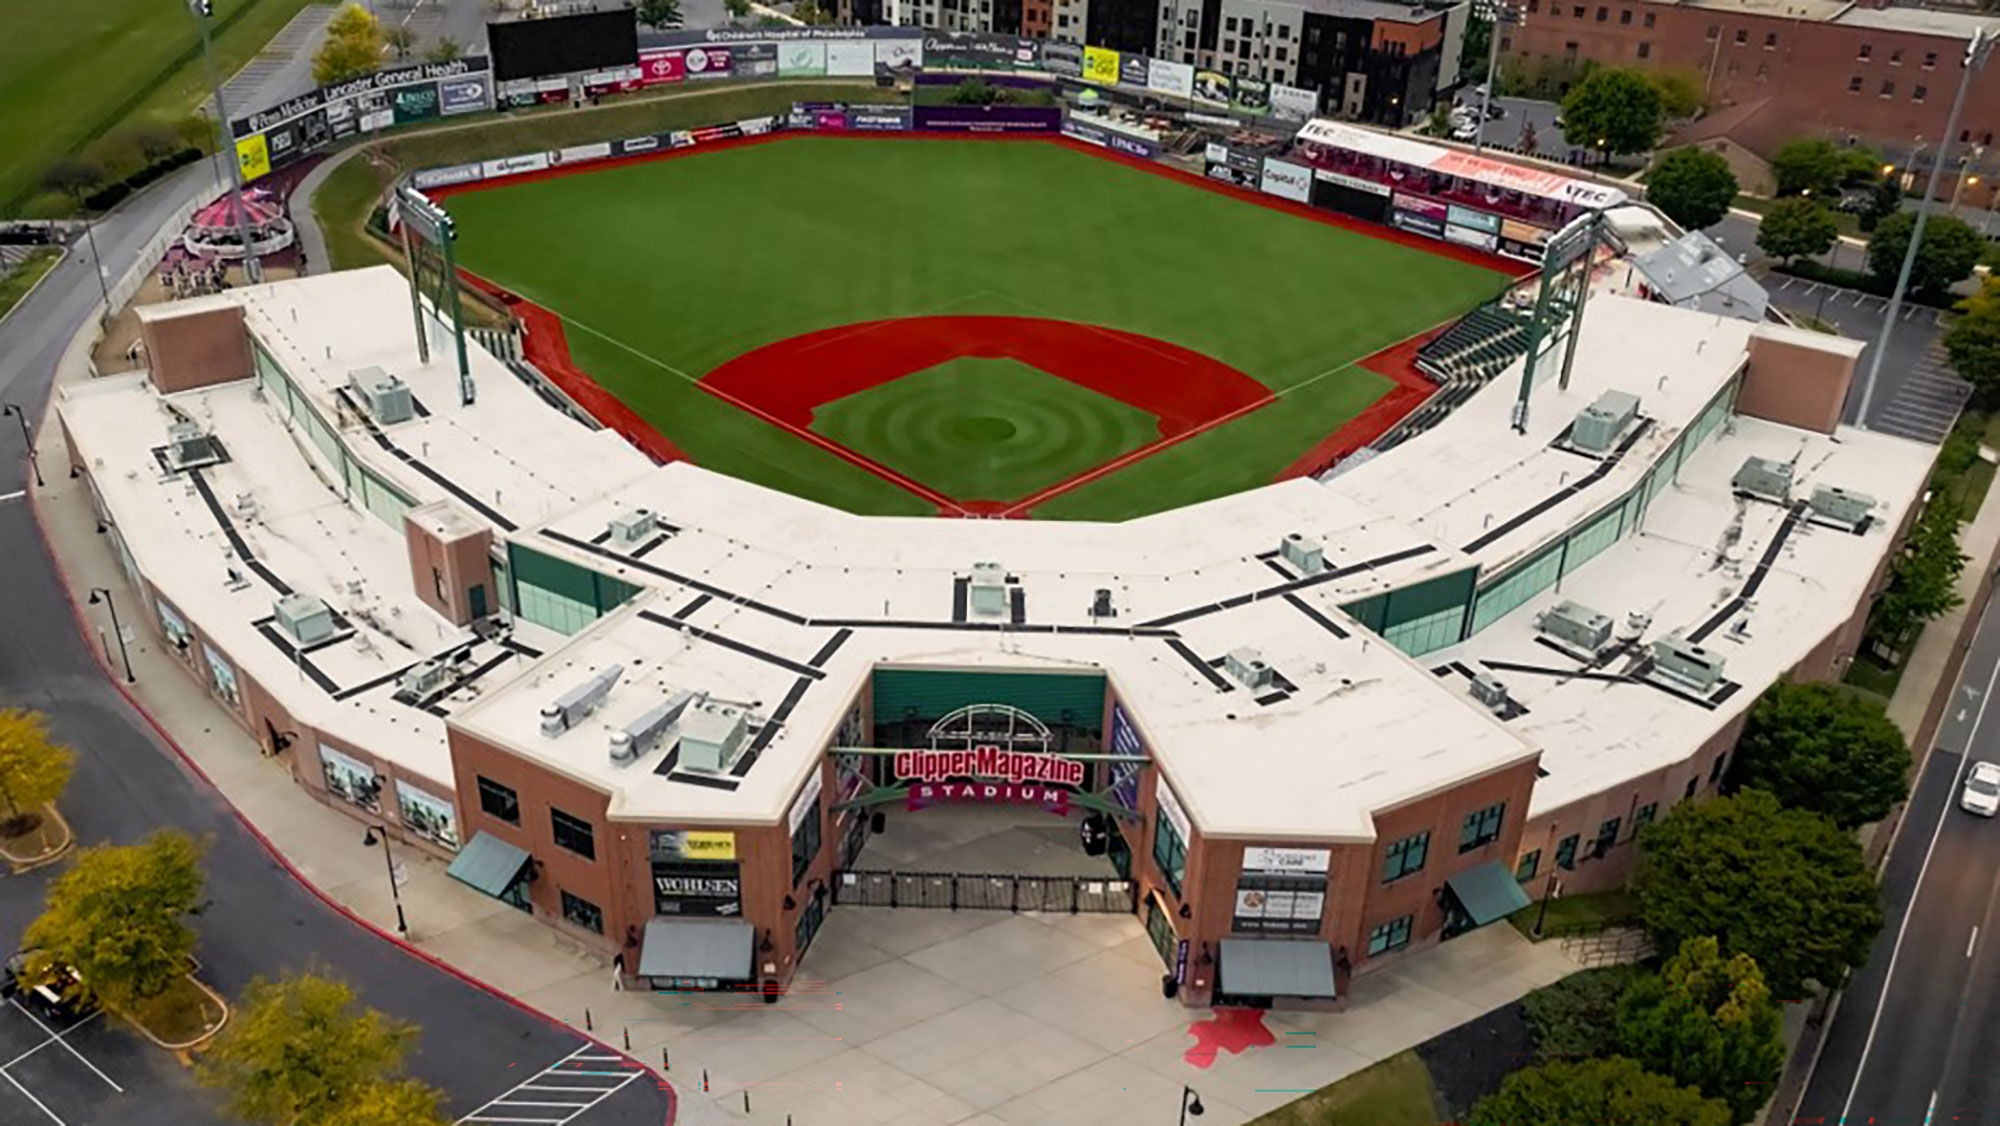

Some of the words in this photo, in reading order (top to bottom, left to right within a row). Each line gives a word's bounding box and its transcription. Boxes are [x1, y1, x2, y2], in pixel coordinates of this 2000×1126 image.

[375, 65, 423, 87] General
[425, 59, 469, 79] Health
[919, 785, 1059, 802] STADIUM
[655, 878, 738, 892] WOHLSEN
